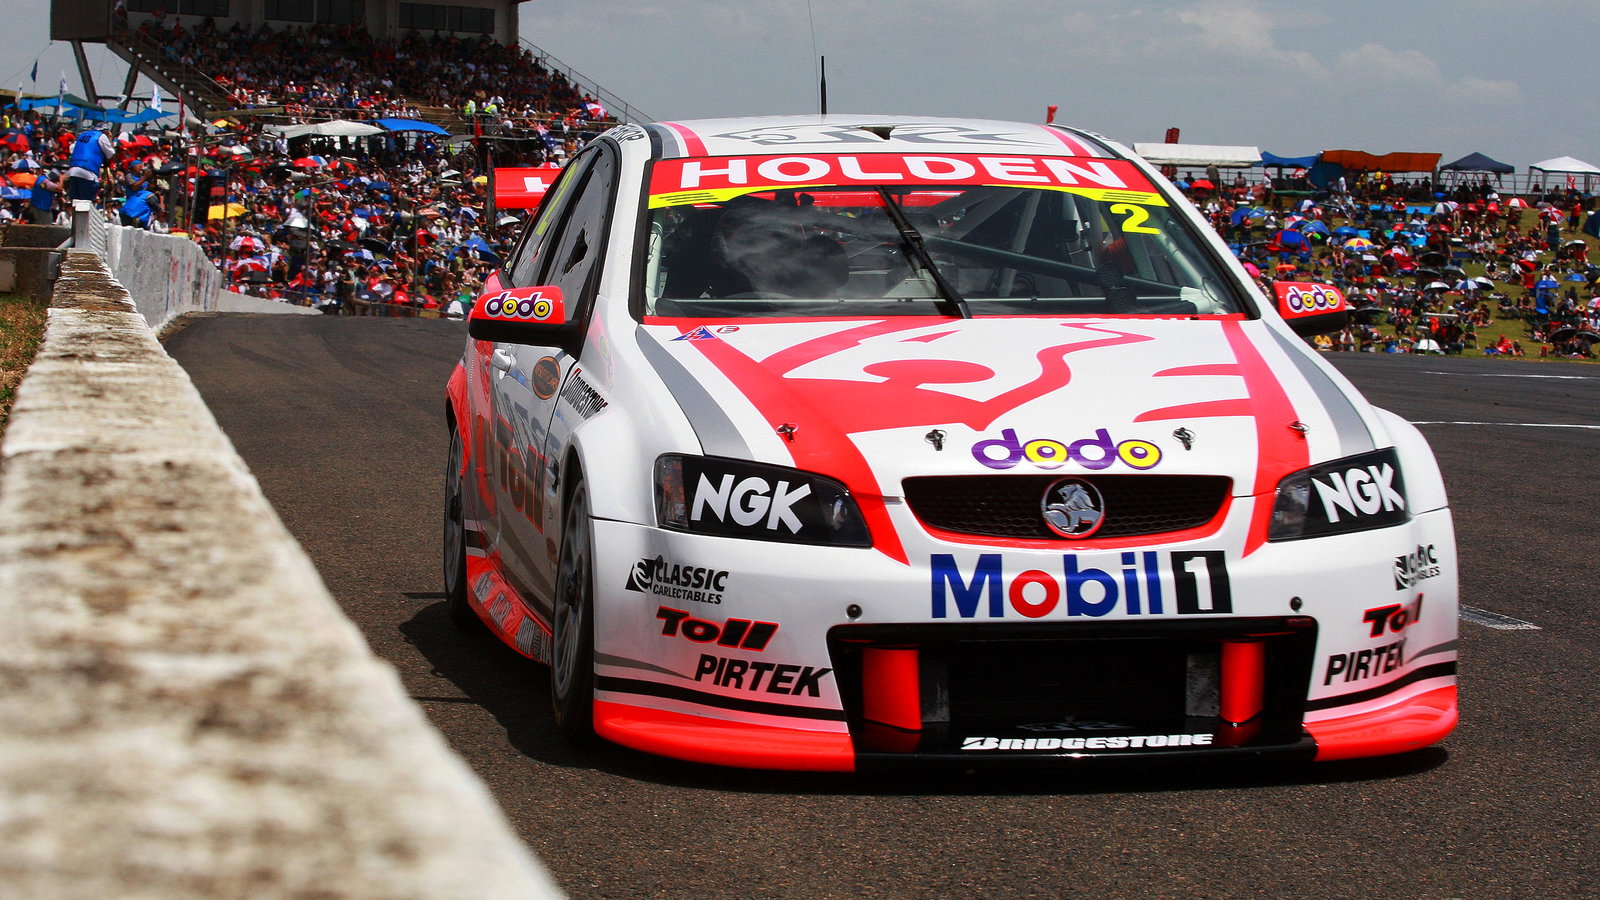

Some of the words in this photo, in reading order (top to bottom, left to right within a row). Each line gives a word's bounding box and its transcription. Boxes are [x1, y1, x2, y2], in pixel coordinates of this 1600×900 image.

[680, 155, 1128, 189] HOLDEN
[1110, 203, 1161, 235] 2
[484, 290, 554, 319] dodo
[1287, 285, 1340, 313] dodo
[971, 428, 1162, 470] dodo
[690, 471, 812, 535] NGK
[1310, 463, 1406, 523] NGK
[655, 562, 730, 592] CLASSIC
[930, 551, 1164, 618] Mobil
[1178, 553, 1220, 612] 1
[653, 584, 723, 605] CARLECTABLES
[656, 606, 779, 652] Toll
[694, 653, 834, 698] PIRTEK
[960, 733, 1214, 751] BRIDGESTONE
